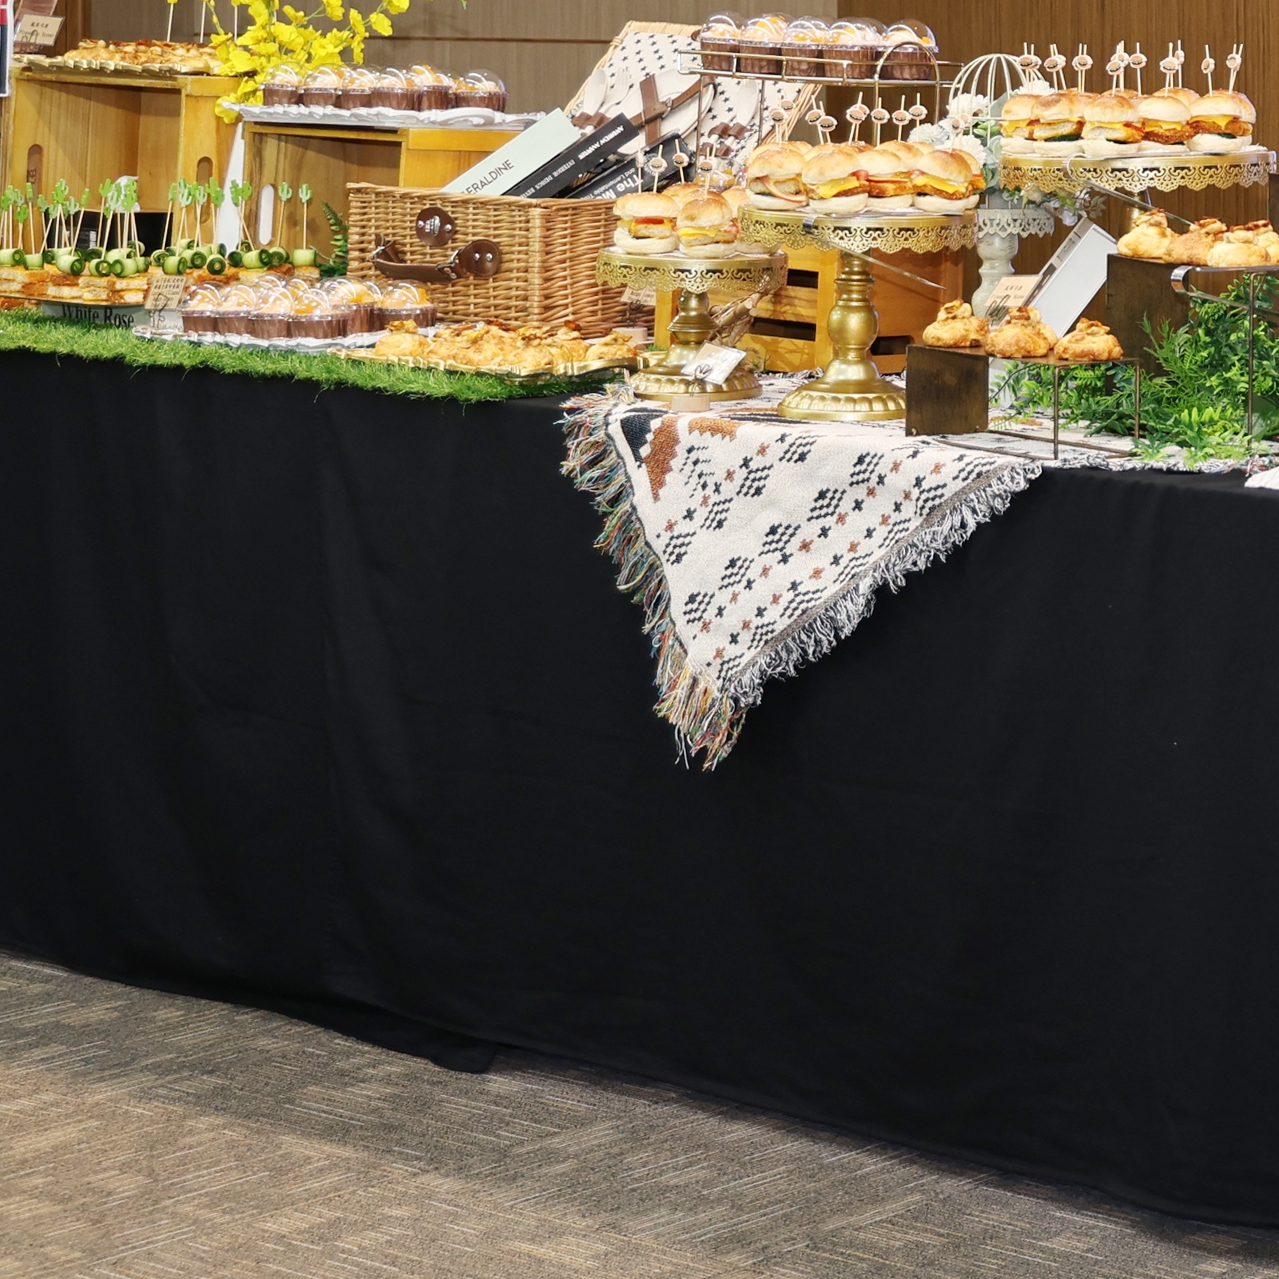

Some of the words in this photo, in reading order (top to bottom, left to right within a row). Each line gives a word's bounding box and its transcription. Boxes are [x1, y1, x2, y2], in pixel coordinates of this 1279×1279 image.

[461, 159, 514, 195] ERALDINE
[616, 174, 643, 192] The
[61, 304, 100, 323] White
[104, 305, 135, 328] Rose
